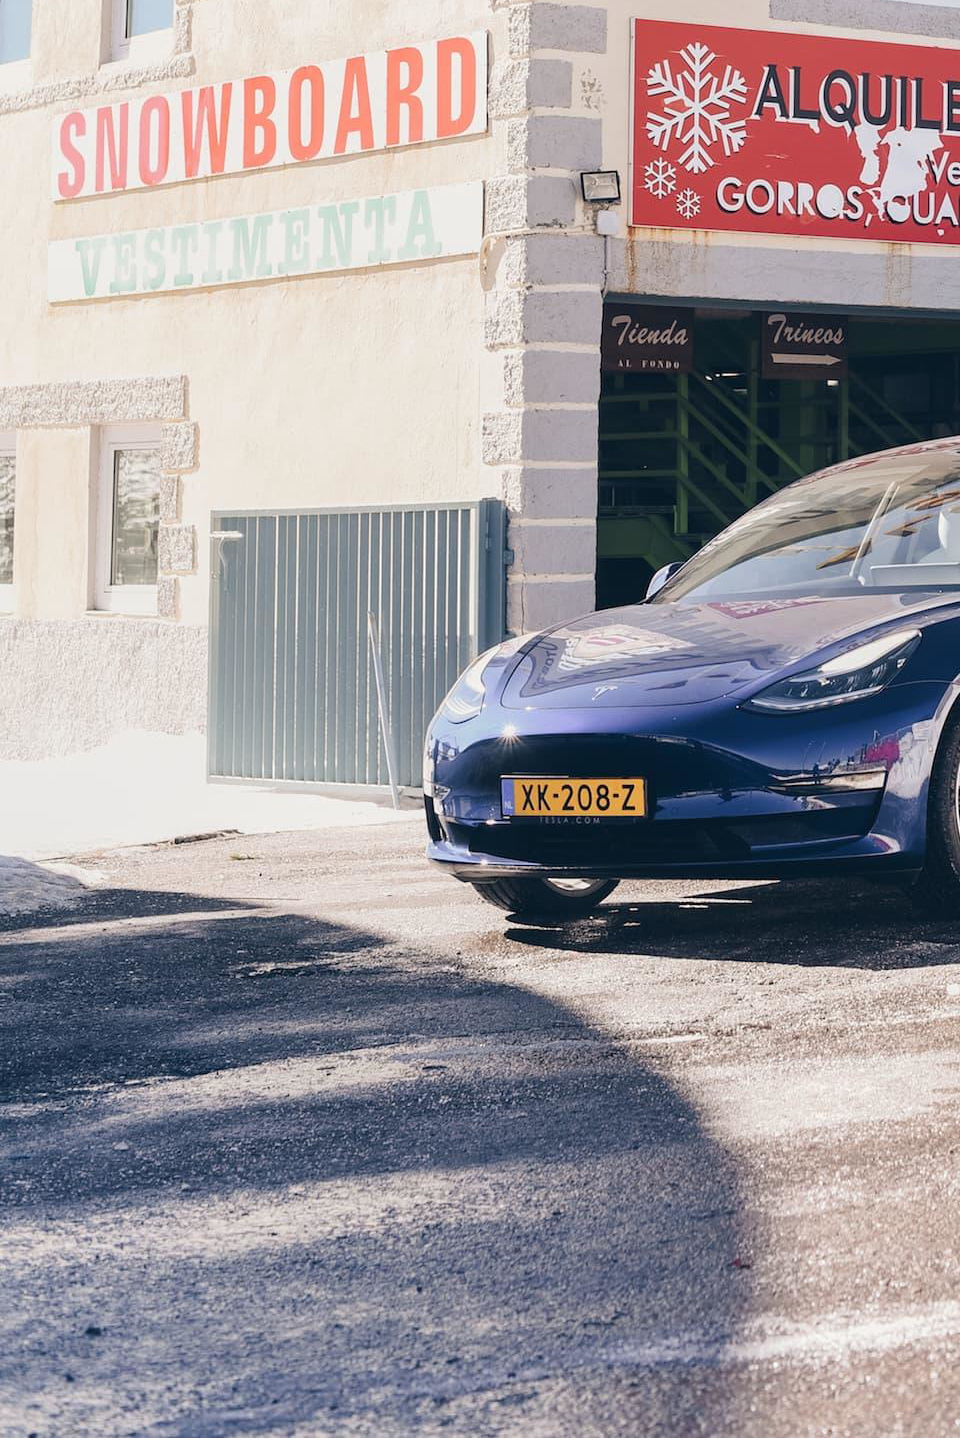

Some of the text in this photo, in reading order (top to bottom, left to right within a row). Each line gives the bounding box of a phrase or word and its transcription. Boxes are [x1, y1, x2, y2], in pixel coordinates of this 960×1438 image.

[57, 35, 479, 199] SNOWBOARD
[716, 175, 874, 228] GORROS,
[75, 189, 443, 297] VESTIMENTA
[611, 314, 689, 347] Tienda
[767, 313, 845, 346] Trineos
[617, 359, 681, 370] AL FONDO
[504, 801, 513, 810] NL
[521, 784, 636, 811] XK-208-Z
